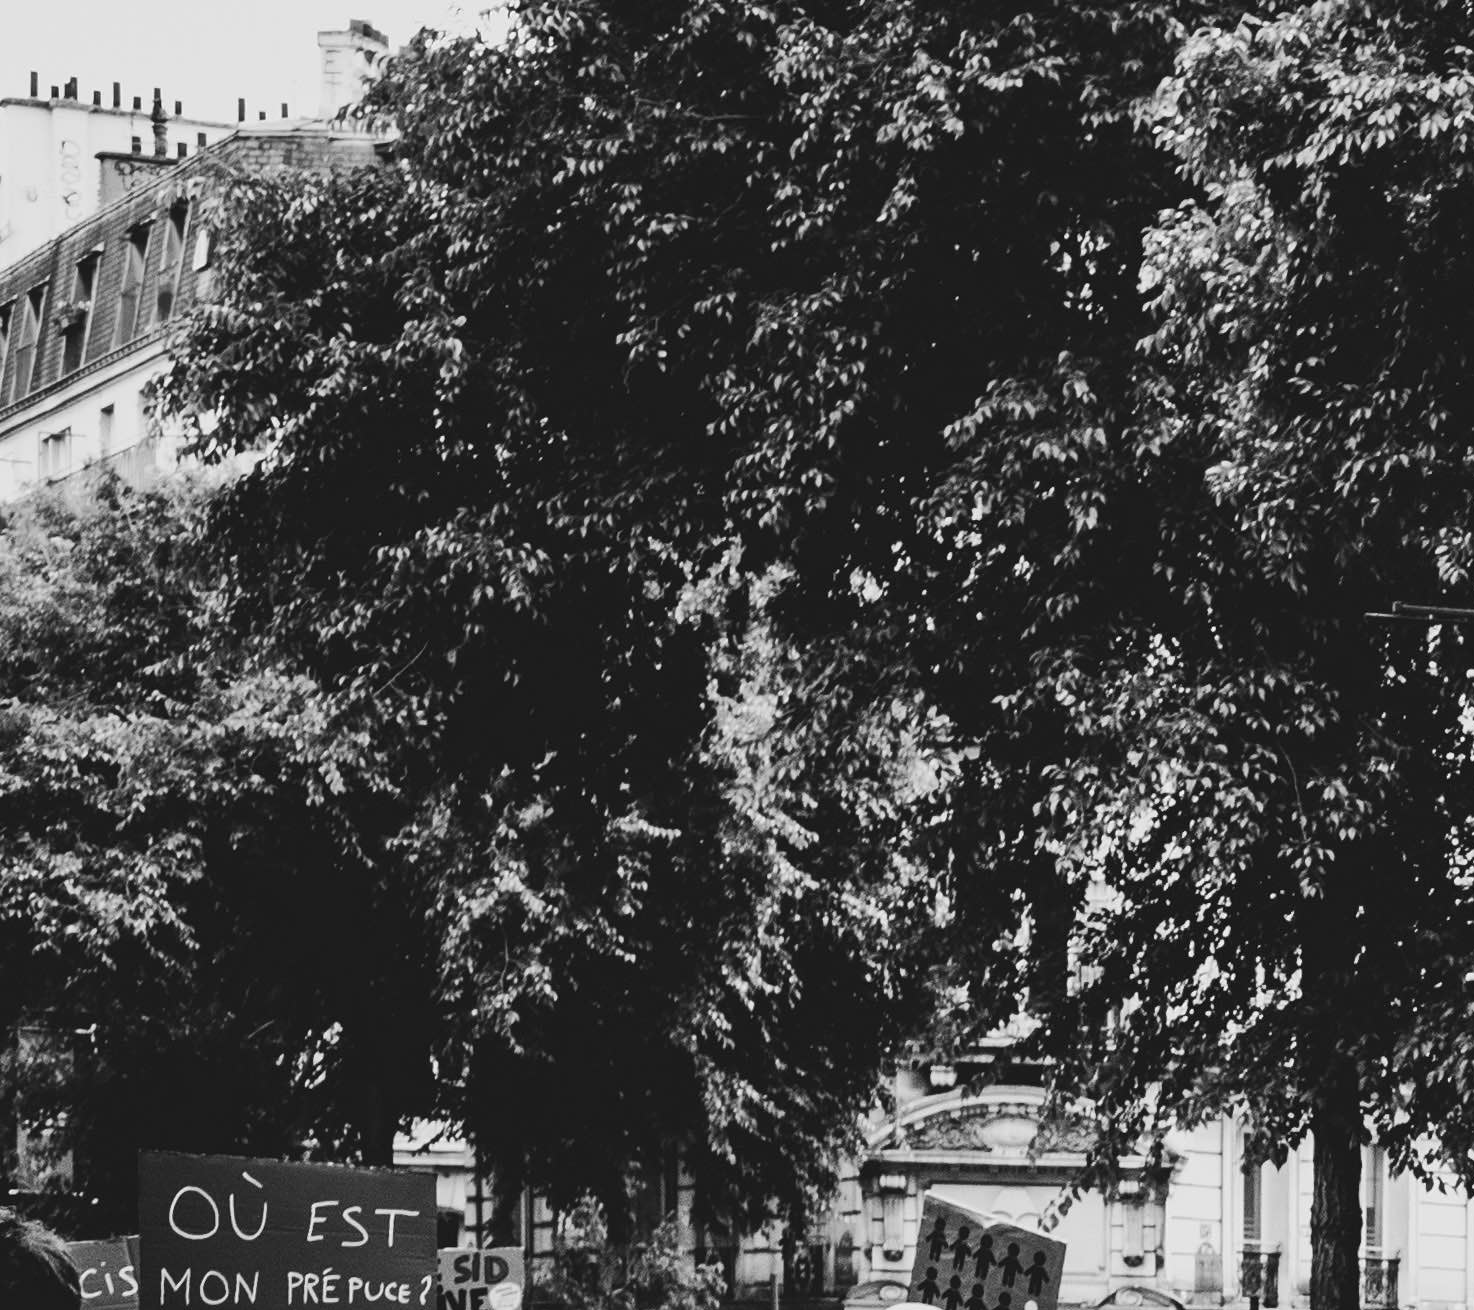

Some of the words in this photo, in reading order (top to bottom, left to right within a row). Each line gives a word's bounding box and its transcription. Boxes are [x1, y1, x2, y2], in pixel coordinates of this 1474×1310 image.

[169, 1171, 268, 1241] OÙ
[306, 1200, 420, 1248] EST
[160, 1267, 259, 1306] MON
